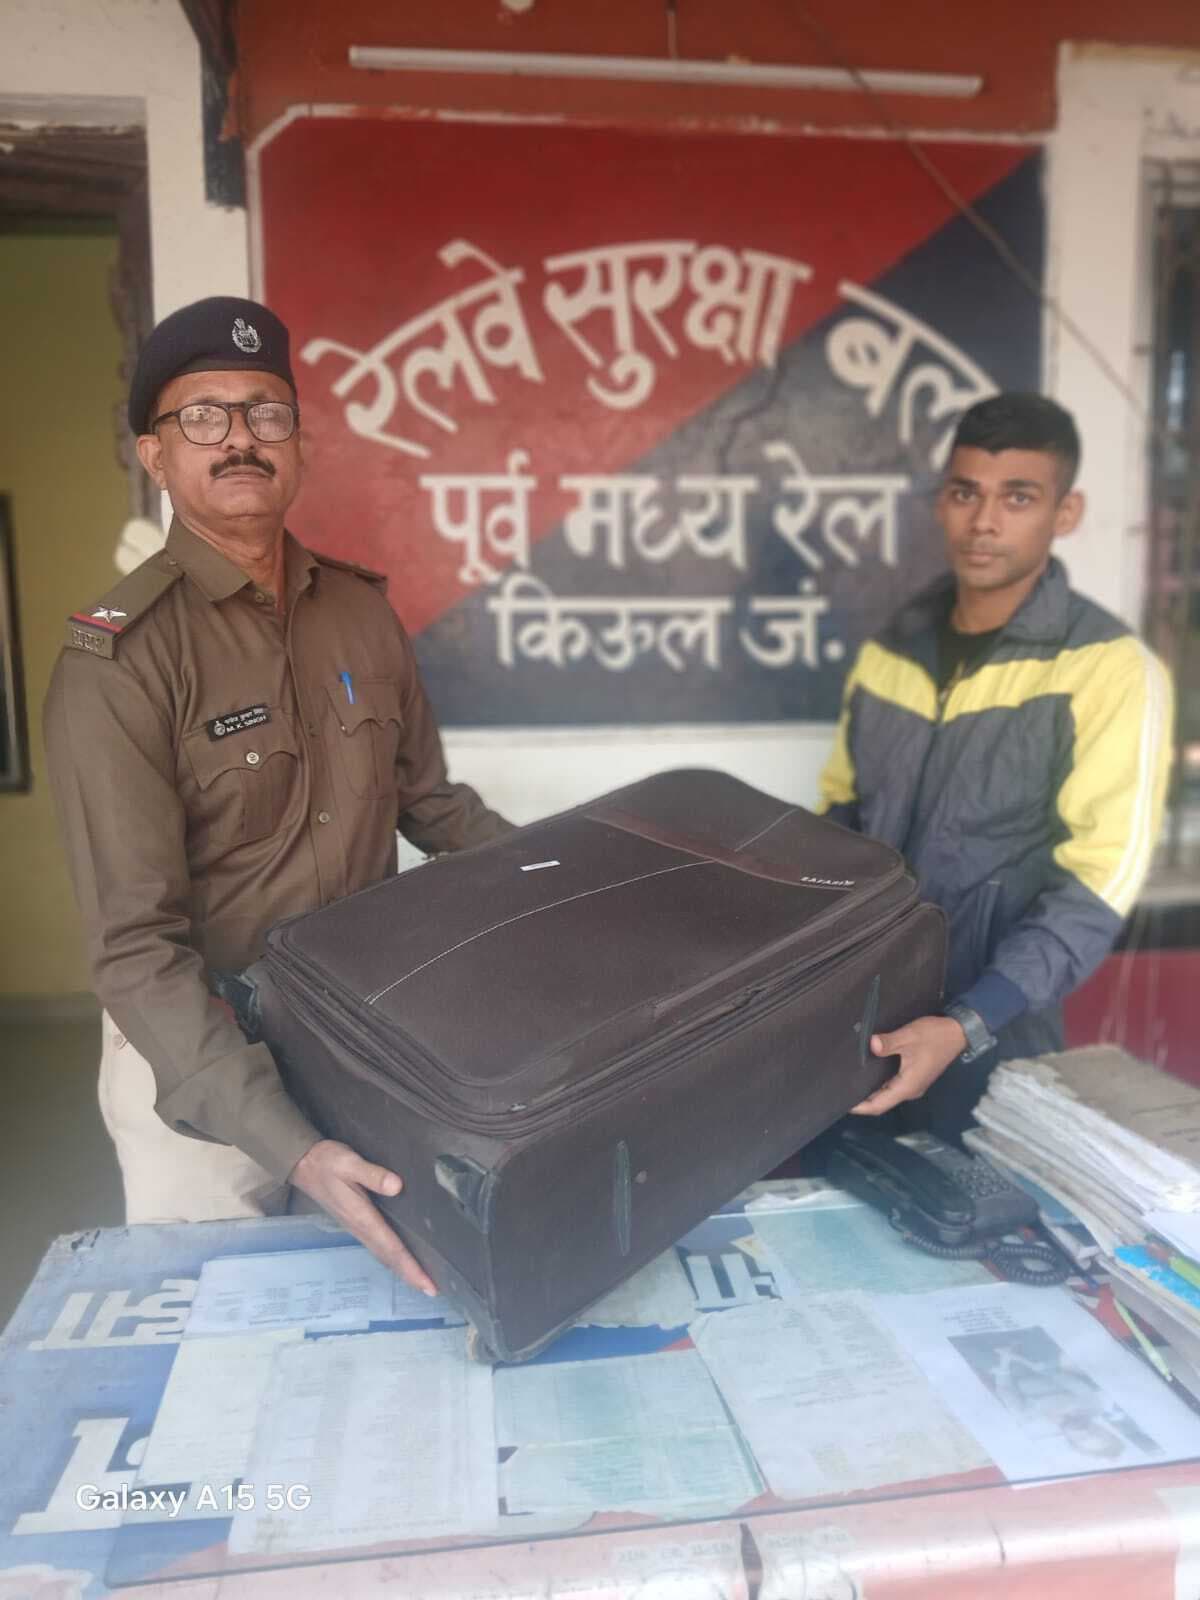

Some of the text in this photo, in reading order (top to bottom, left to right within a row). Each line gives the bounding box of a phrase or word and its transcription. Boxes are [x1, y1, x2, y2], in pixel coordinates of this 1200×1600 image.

[302, 239, 1001, 472] रेलवे सुरक्षा बल
[420, 442, 908, 584] पूर्व मध्य रेल
[487, 570, 731, 670] किऊल
